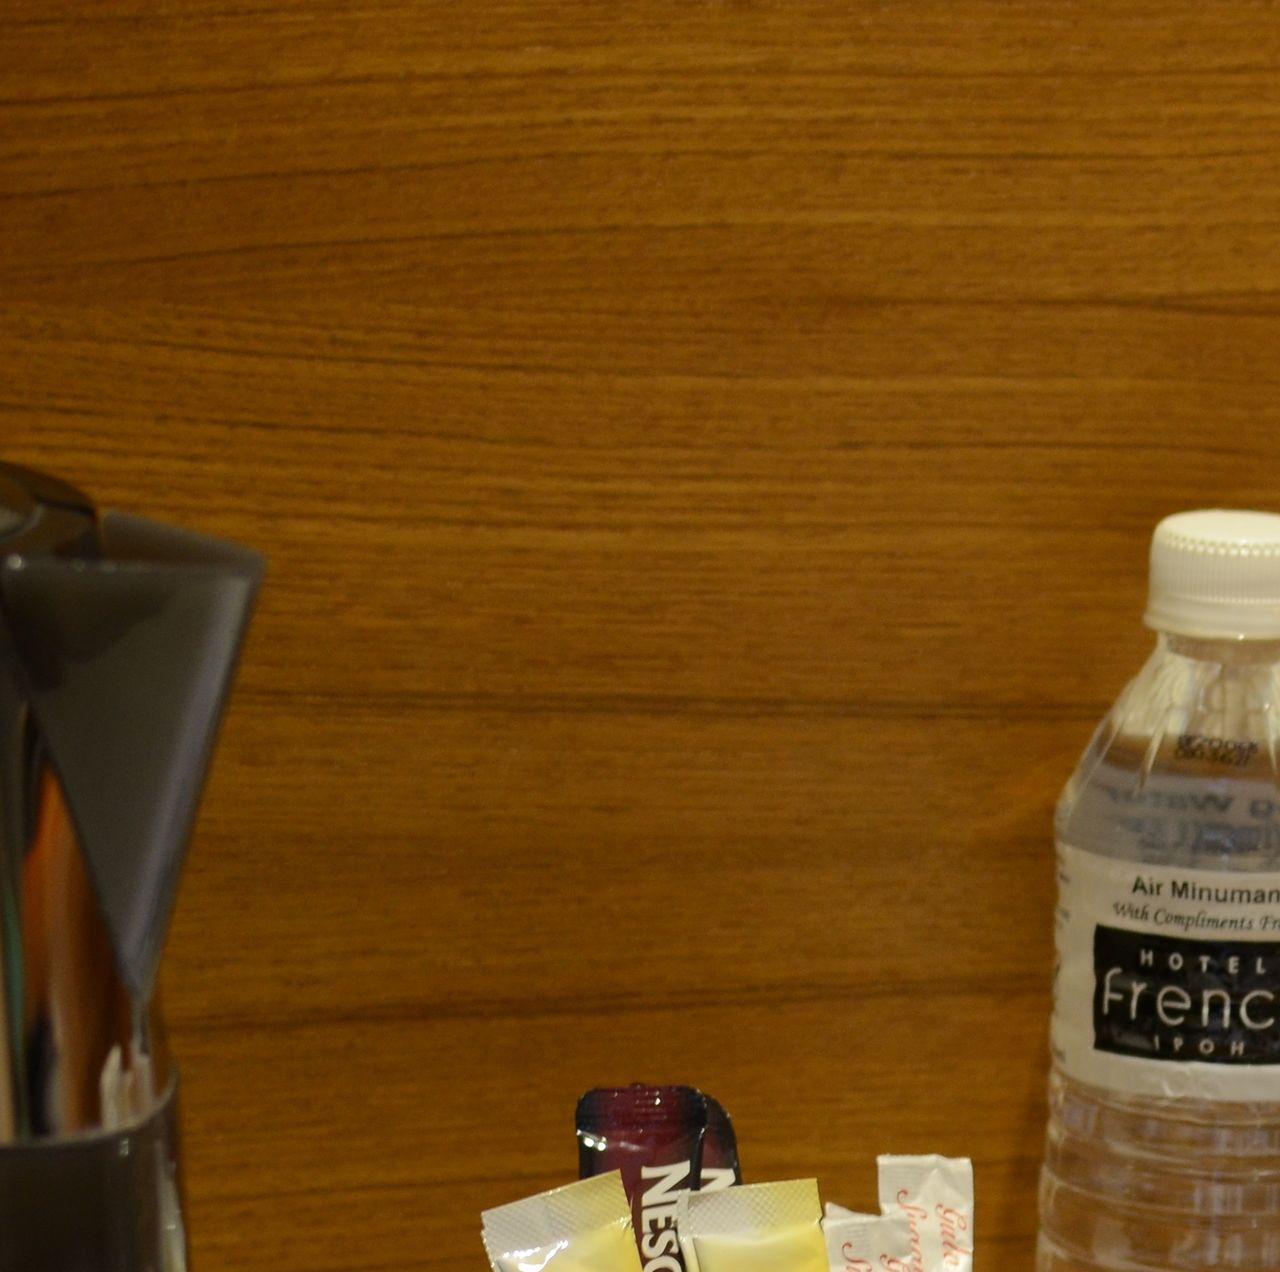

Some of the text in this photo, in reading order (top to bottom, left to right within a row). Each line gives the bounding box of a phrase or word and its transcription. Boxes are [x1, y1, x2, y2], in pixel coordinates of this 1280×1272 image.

[1131, 875, 1280, 904] Air Minuman
[1112, 900, 1150, 921] With
[1153, 908, 1253, 934] Compliments
[1139, 948, 1267, 975] HOTEL
[1153, 1034, 1245, 1057] IPOH
